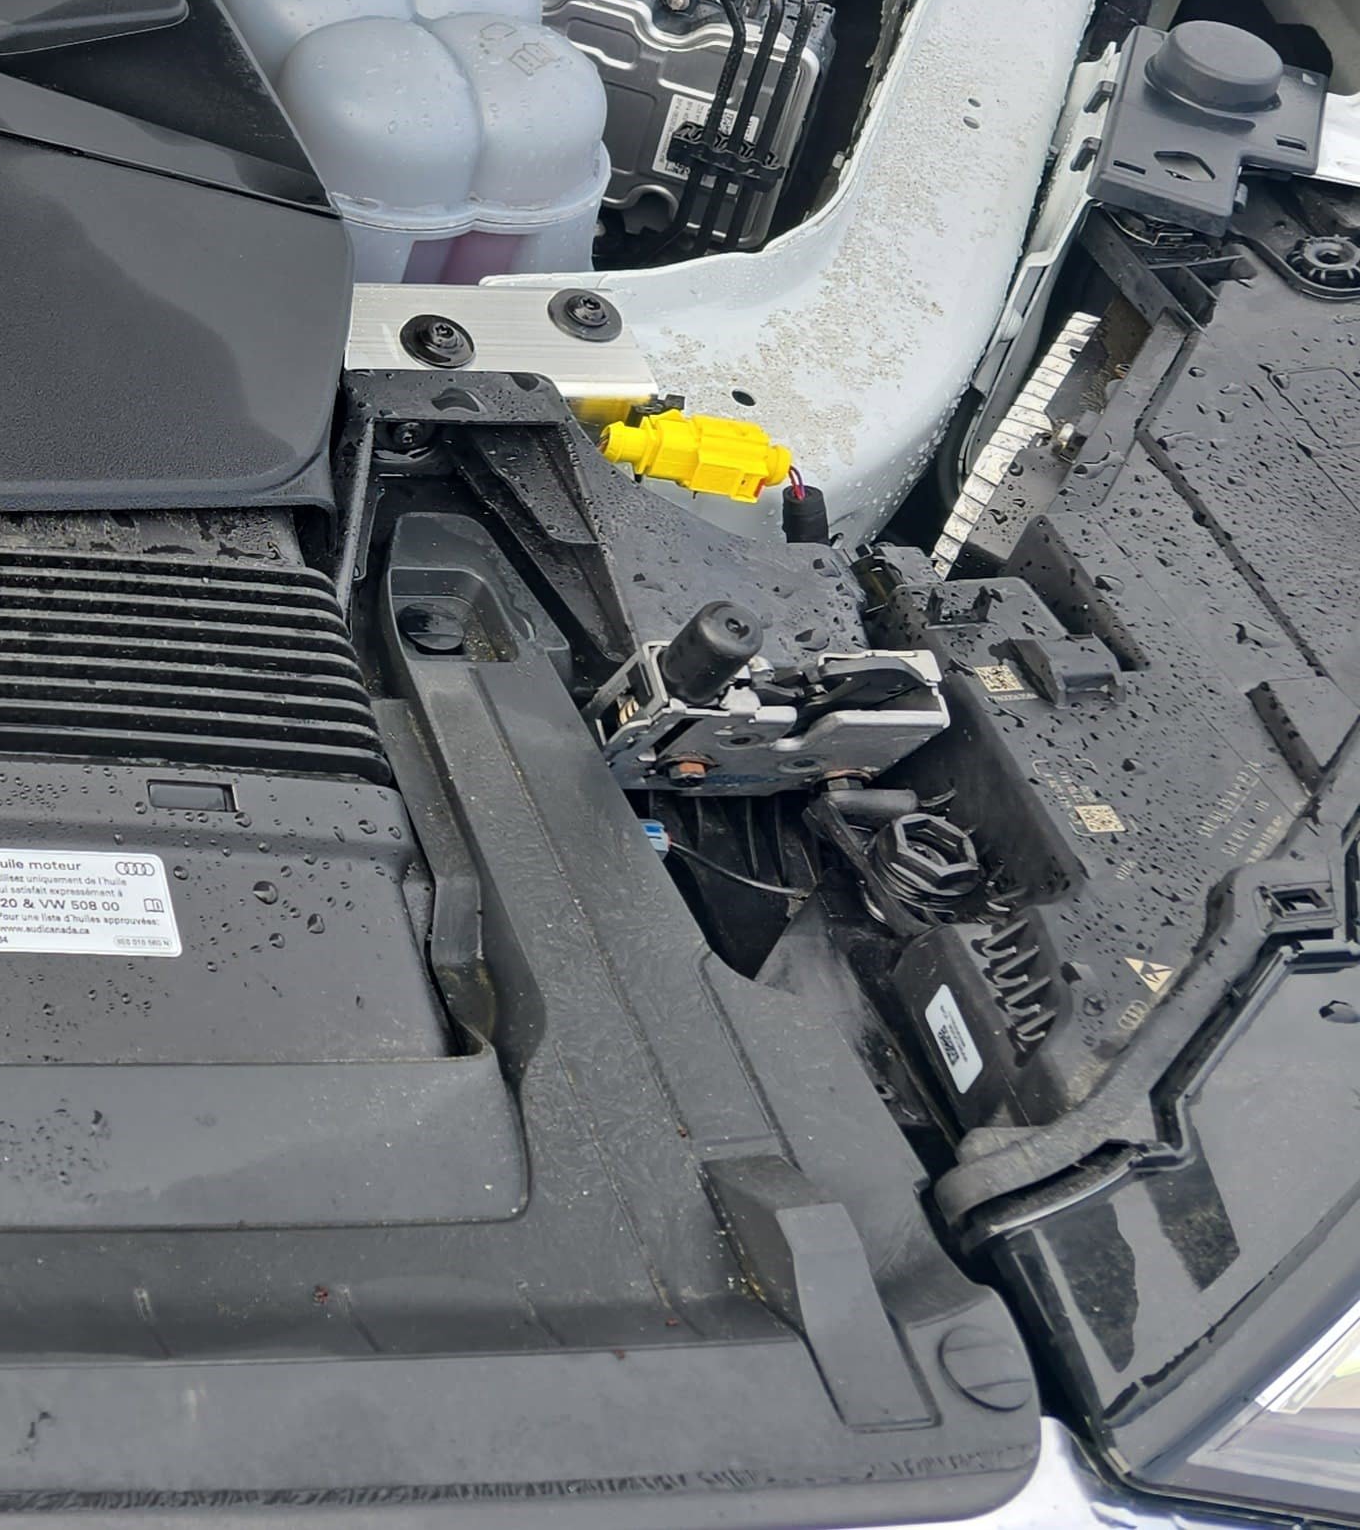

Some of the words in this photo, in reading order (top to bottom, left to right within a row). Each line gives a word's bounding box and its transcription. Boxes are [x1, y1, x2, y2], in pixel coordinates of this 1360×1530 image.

[29, 861, 82, 871] moteur
[25, 875, 83, 885] uniquement
[84, 876, 96, 885] de
[10, 886, 47, 895] satisfait
[49, 886, 115, 897] expressément
[22, 898, 36, 909] &
[38, 899, 67, 910] VW
[71, 901, 98, 911] 508
[101, 901, 120, 911] 00
[21, 914, 39, 922] une
[41, 913, 61, 922] liste
